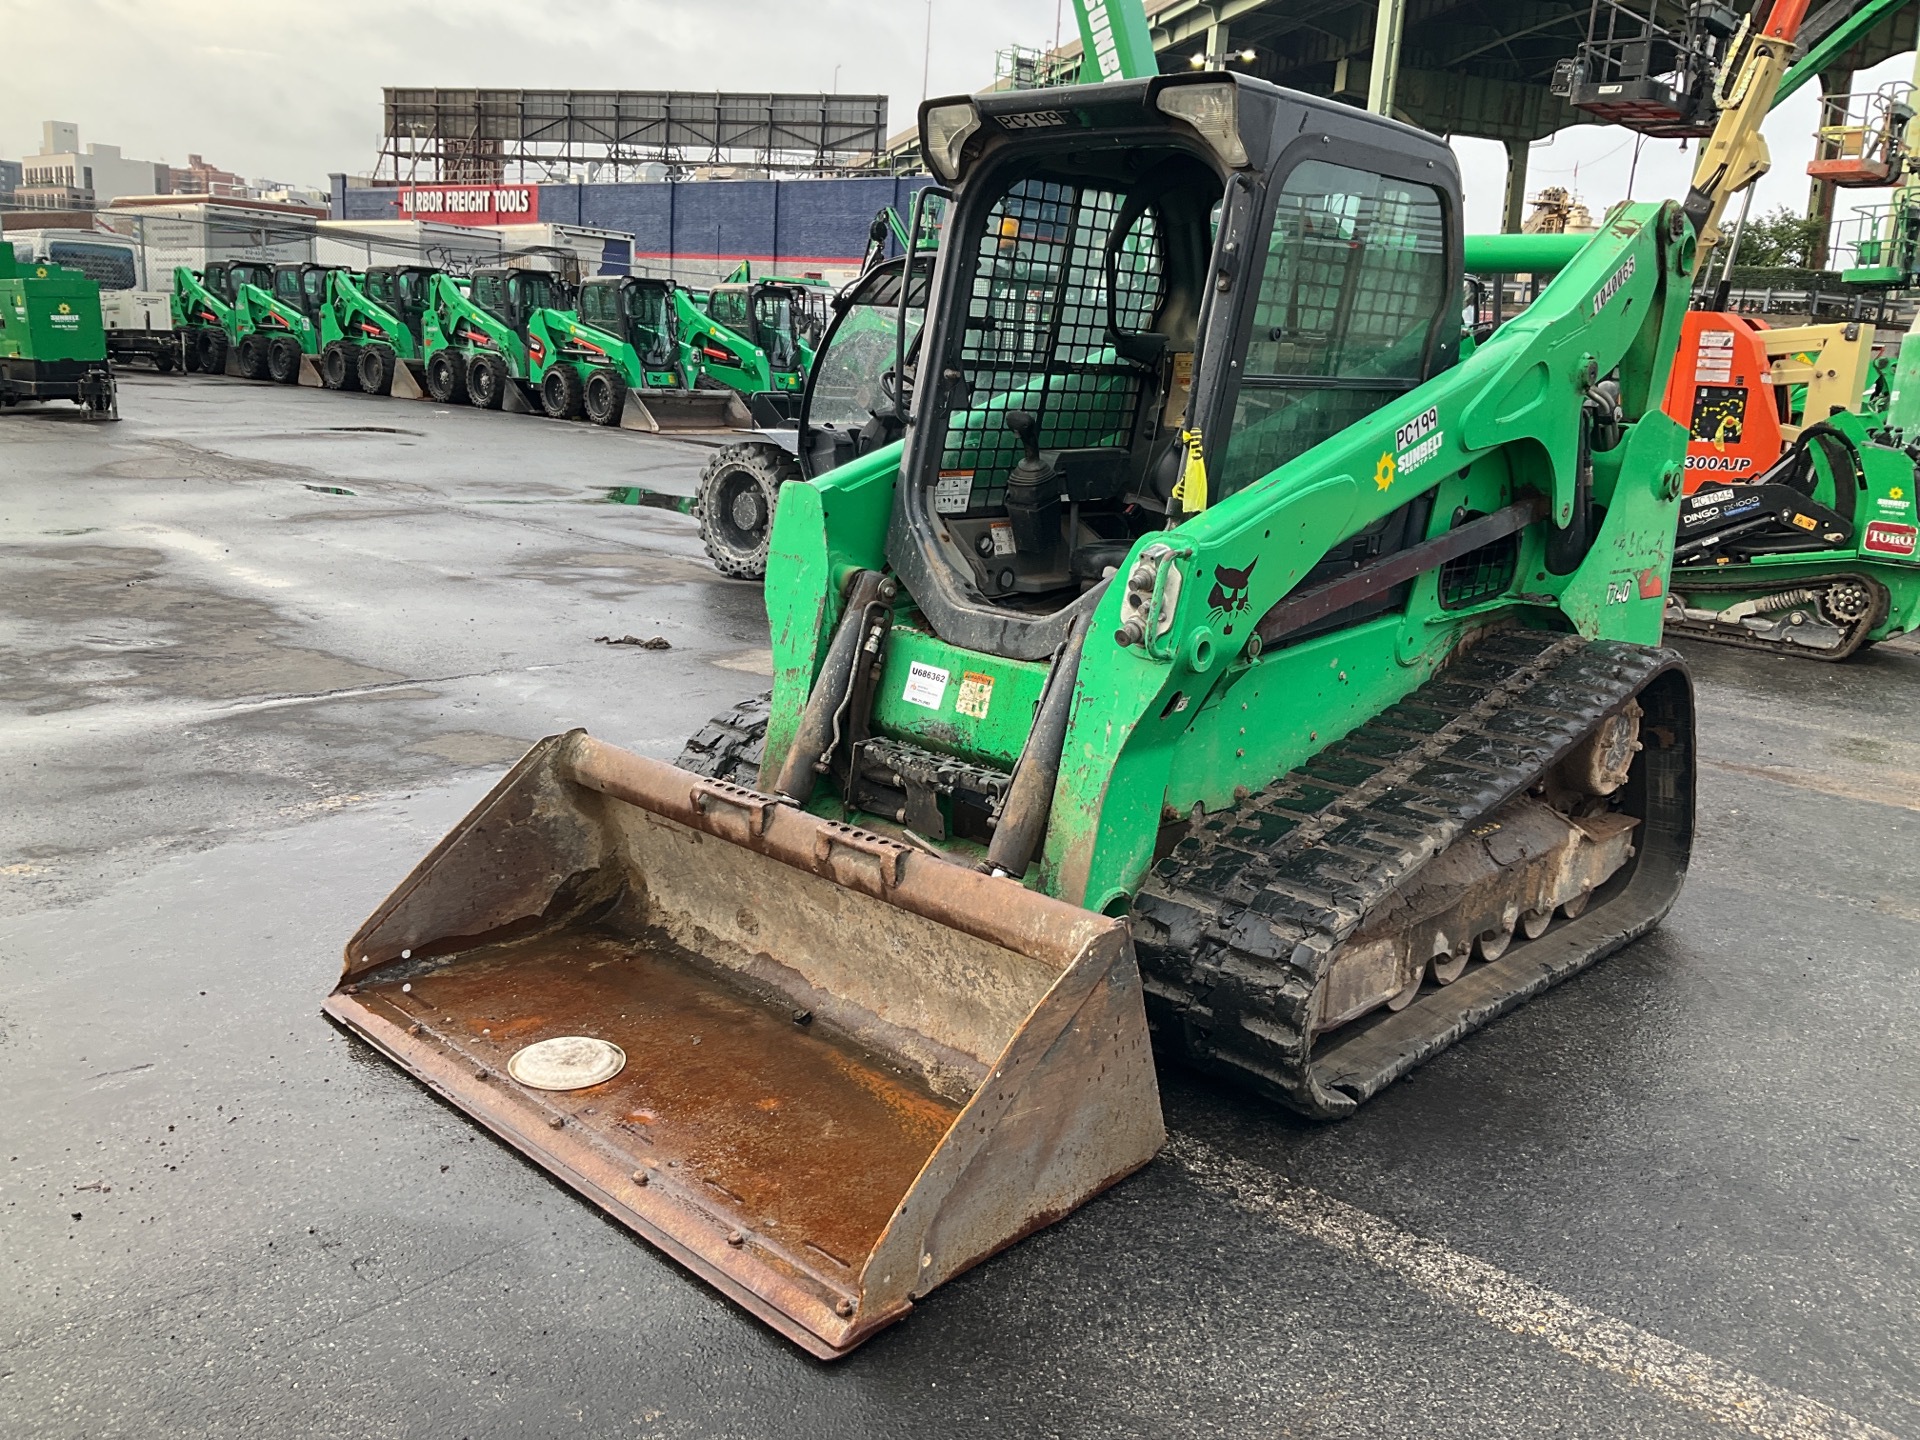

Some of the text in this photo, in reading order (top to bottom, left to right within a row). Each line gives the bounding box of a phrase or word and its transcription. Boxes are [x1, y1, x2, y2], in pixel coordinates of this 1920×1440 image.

[999, 111, 1065, 129] PC199
[445, 191, 491, 212] FREIGHT
[493, 190, 529, 213] TOOLS
[1396, 408, 1437, 451] PC199
[1397, 431, 1444, 473] SUNBELT
[1404, 450, 1438, 476] RENTALS
[1684, 456, 1752, 472] 300AJP
[1683, 507, 1719, 524] DINGO
[912, 667, 946, 683] U686362
